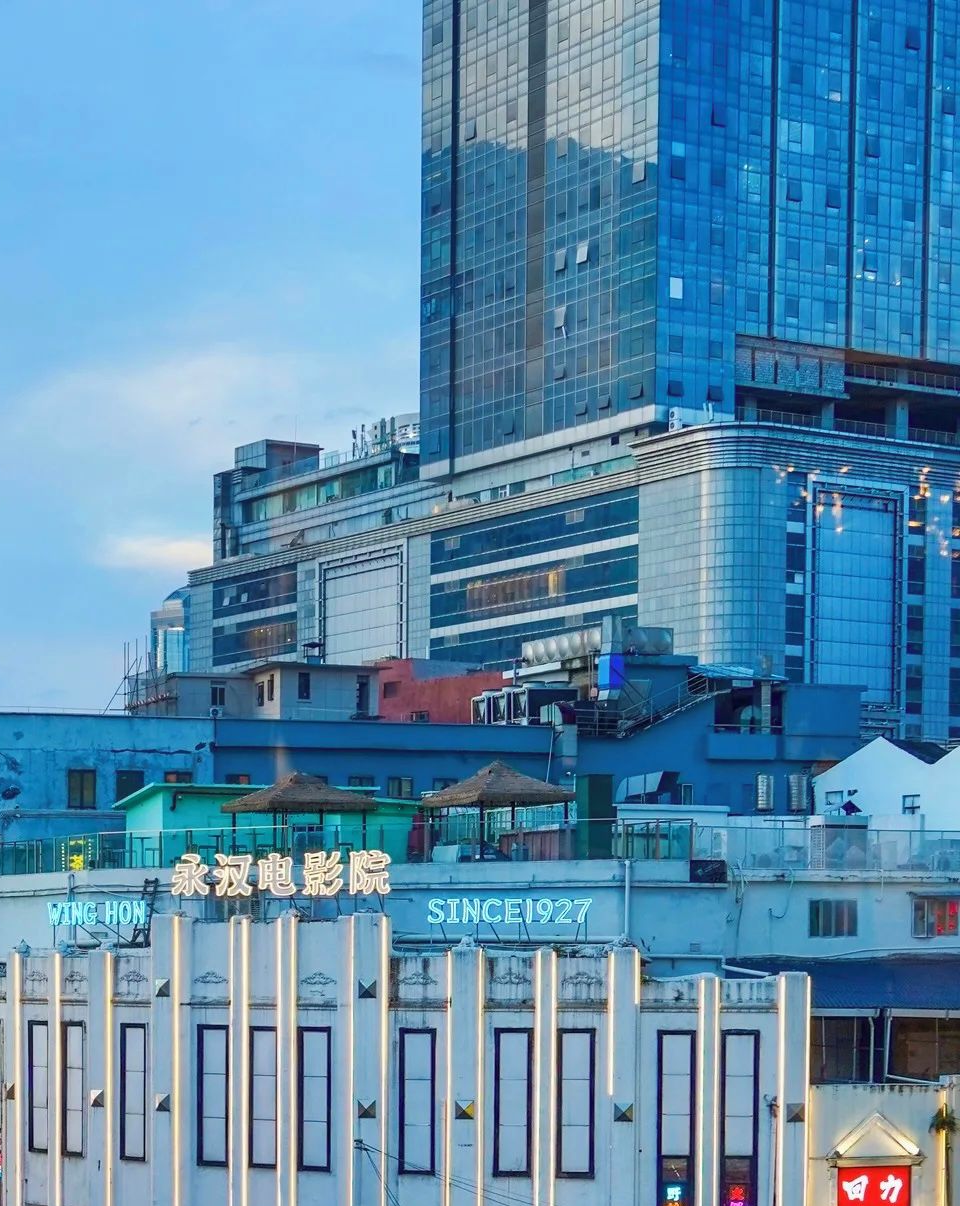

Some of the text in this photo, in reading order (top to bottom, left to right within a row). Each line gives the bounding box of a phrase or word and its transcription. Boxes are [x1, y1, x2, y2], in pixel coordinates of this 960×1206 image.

[171, 850, 391, 897] 永汉电影院
[48, 900, 147, 926] WING HON
